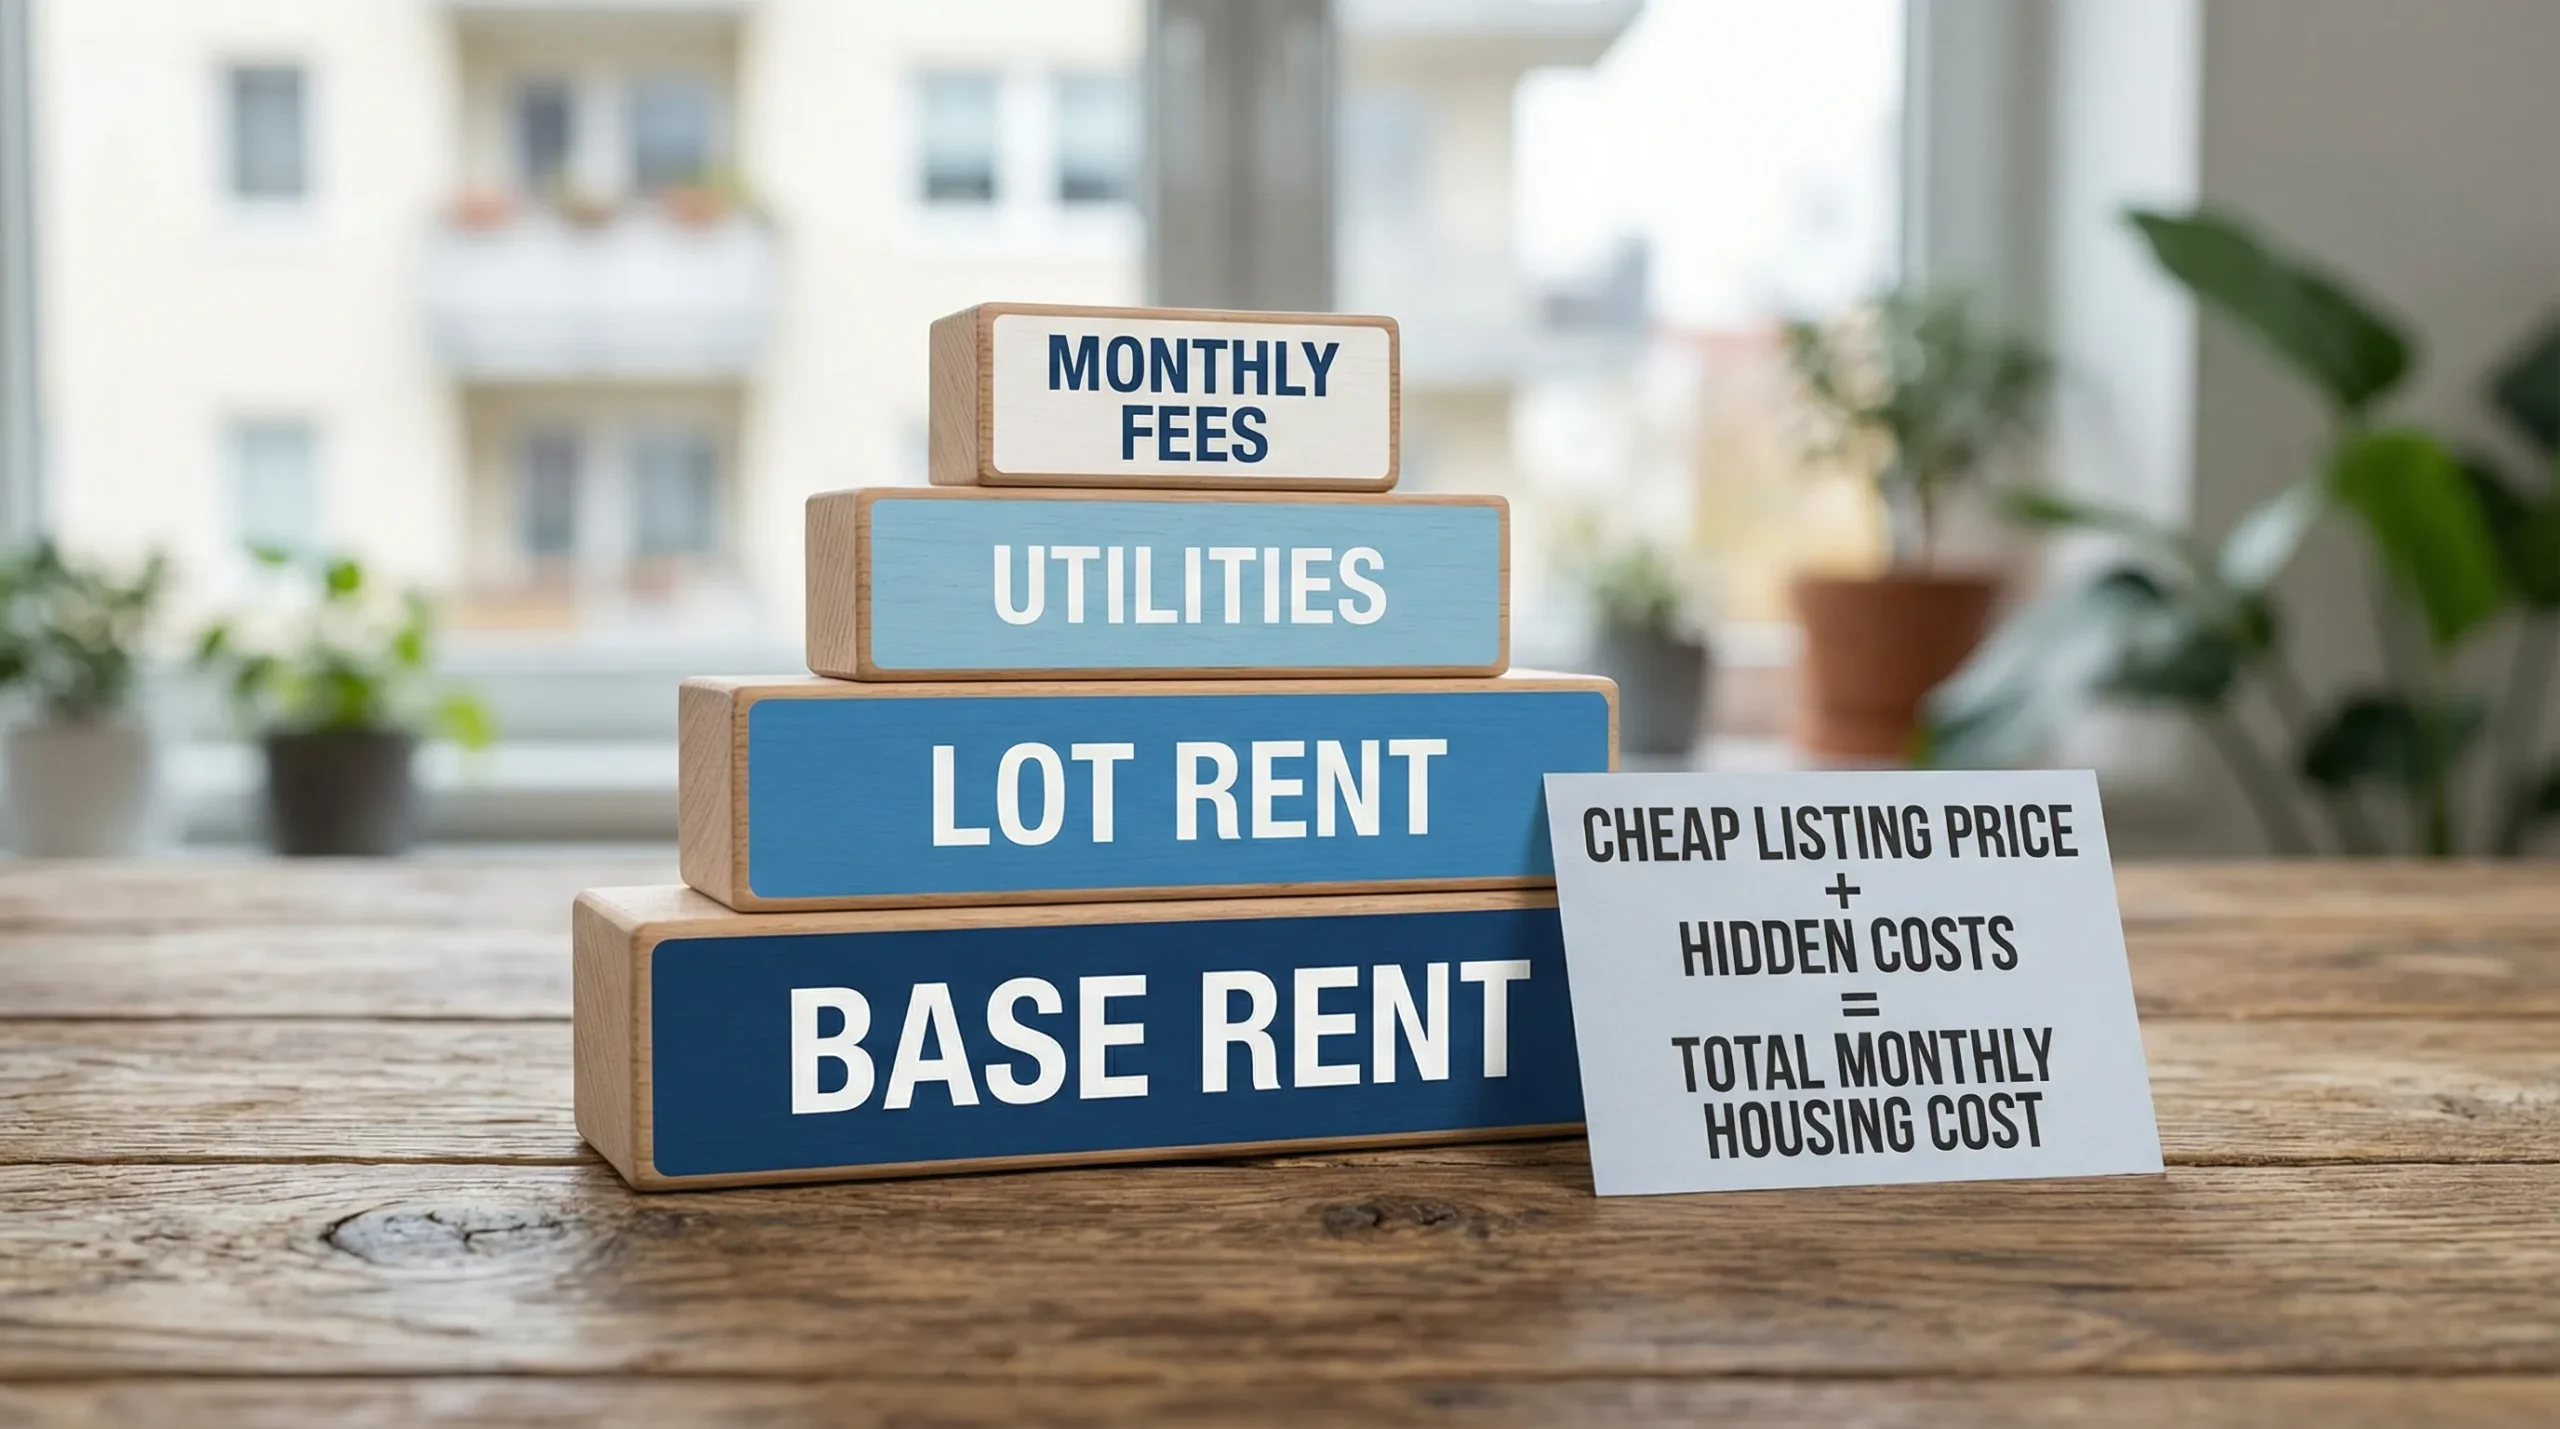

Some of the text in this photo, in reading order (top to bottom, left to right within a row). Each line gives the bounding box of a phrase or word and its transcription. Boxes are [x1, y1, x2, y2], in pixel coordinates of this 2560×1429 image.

[1048, 334, 1340, 397] MONTHLY
[1122, 404, 1269, 464] FEES
[994, 545, 1387, 625] UTILITIES
[933, 739, 1448, 846] LOT RENT
[1583, 803, 2079, 863] CHEAP LISTING PRICE
[1824, 872, 1861, 910] +
[1678, 915, 2019, 977] HIDDEN COSTS
[1840, 992, 1880, 1017] =
[791, 959, 1532, 1114] BASE RENT
[1671, 1027, 2054, 1093] TOTAL MONTHLY
[1703, 1091, 2043, 1160] HOUSING COST
